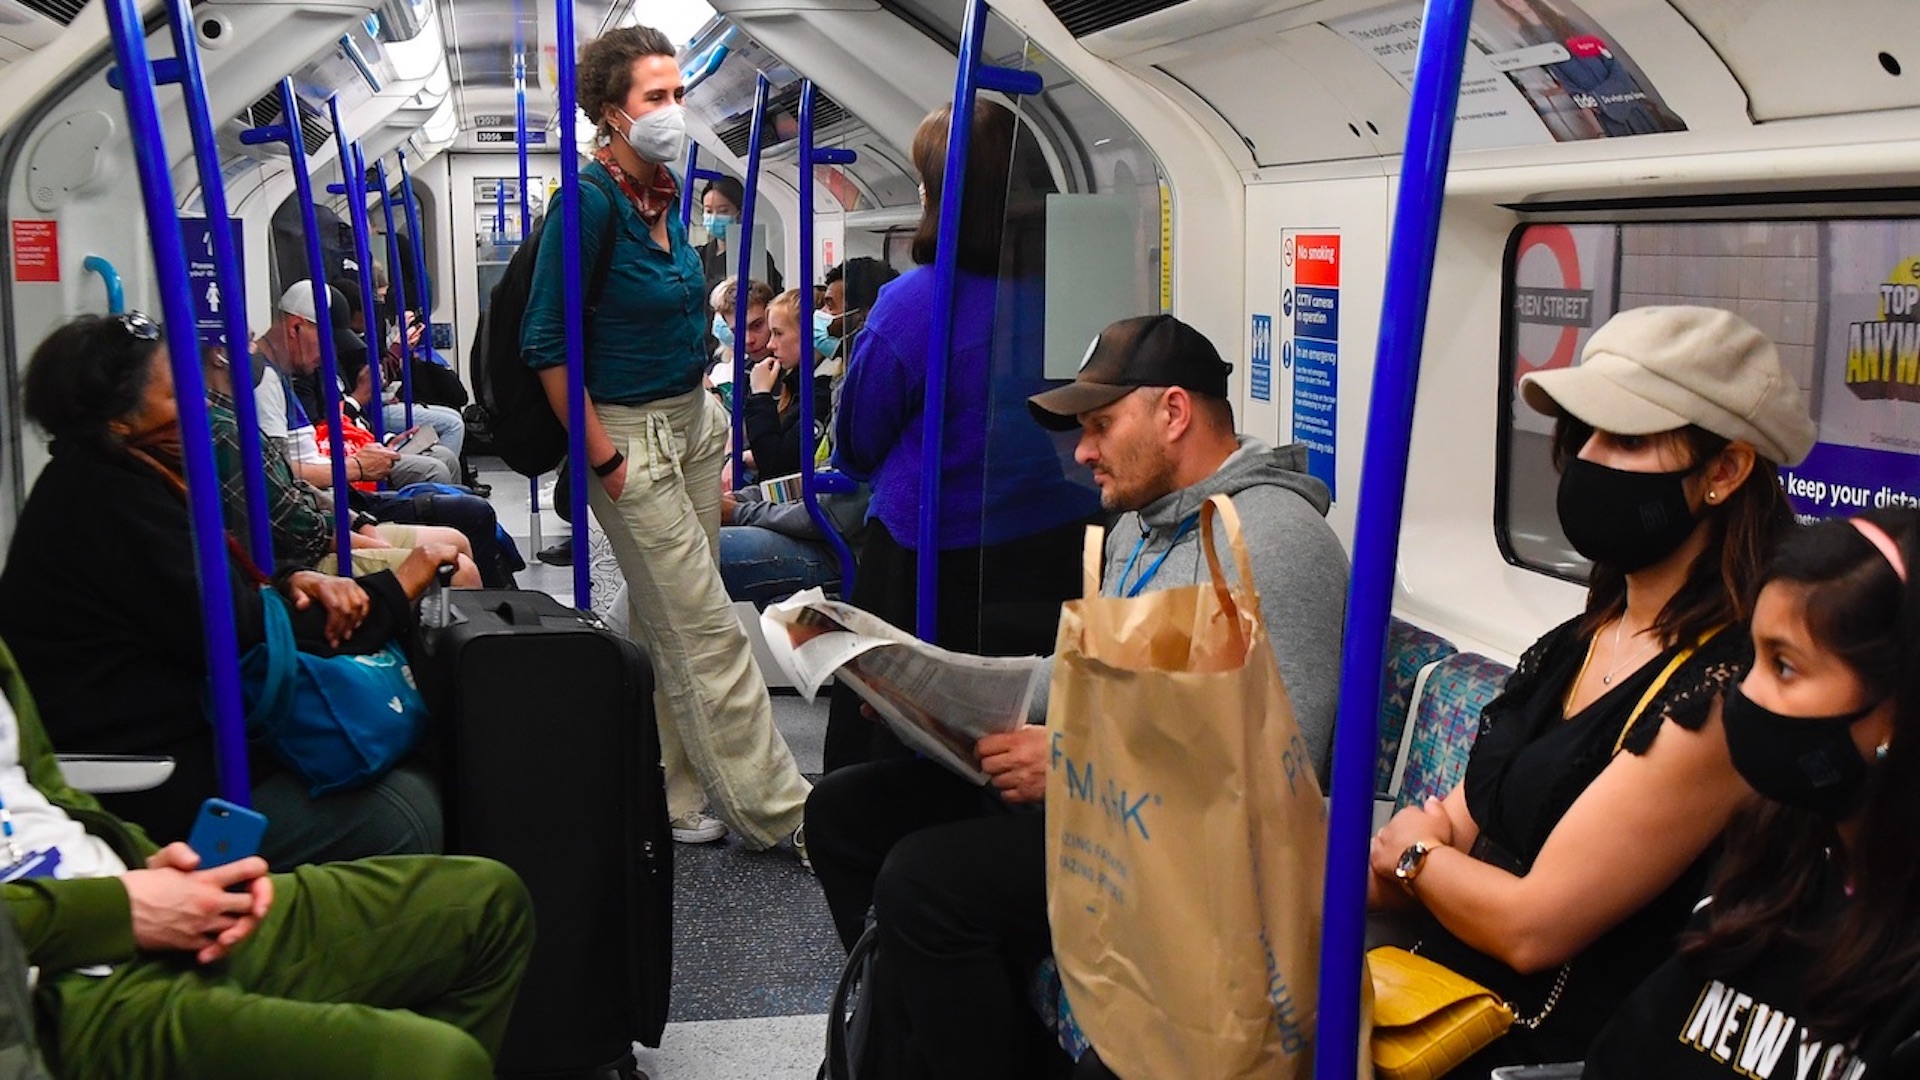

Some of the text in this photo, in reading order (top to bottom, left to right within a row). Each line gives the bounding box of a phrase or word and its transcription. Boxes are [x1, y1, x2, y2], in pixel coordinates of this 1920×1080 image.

[1572, 92, 1599, 109] tide
[1298, 245, 1335, 264] No smoking
[1297, 293, 1335, 309] CCTV cameras
[1516, 294, 1589, 319] REN STREET
[1881, 285, 1919, 315] TOP
[1297, 309, 1328, 324] in operation
[1309, 349, 1337, 365] emergency
[1788, 472, 1827, 505] keep
[1830, 484, 1871, 507] your
[1874, 486, 1920, 509] dista
[1682, 979, 1796, 1080] NEW
